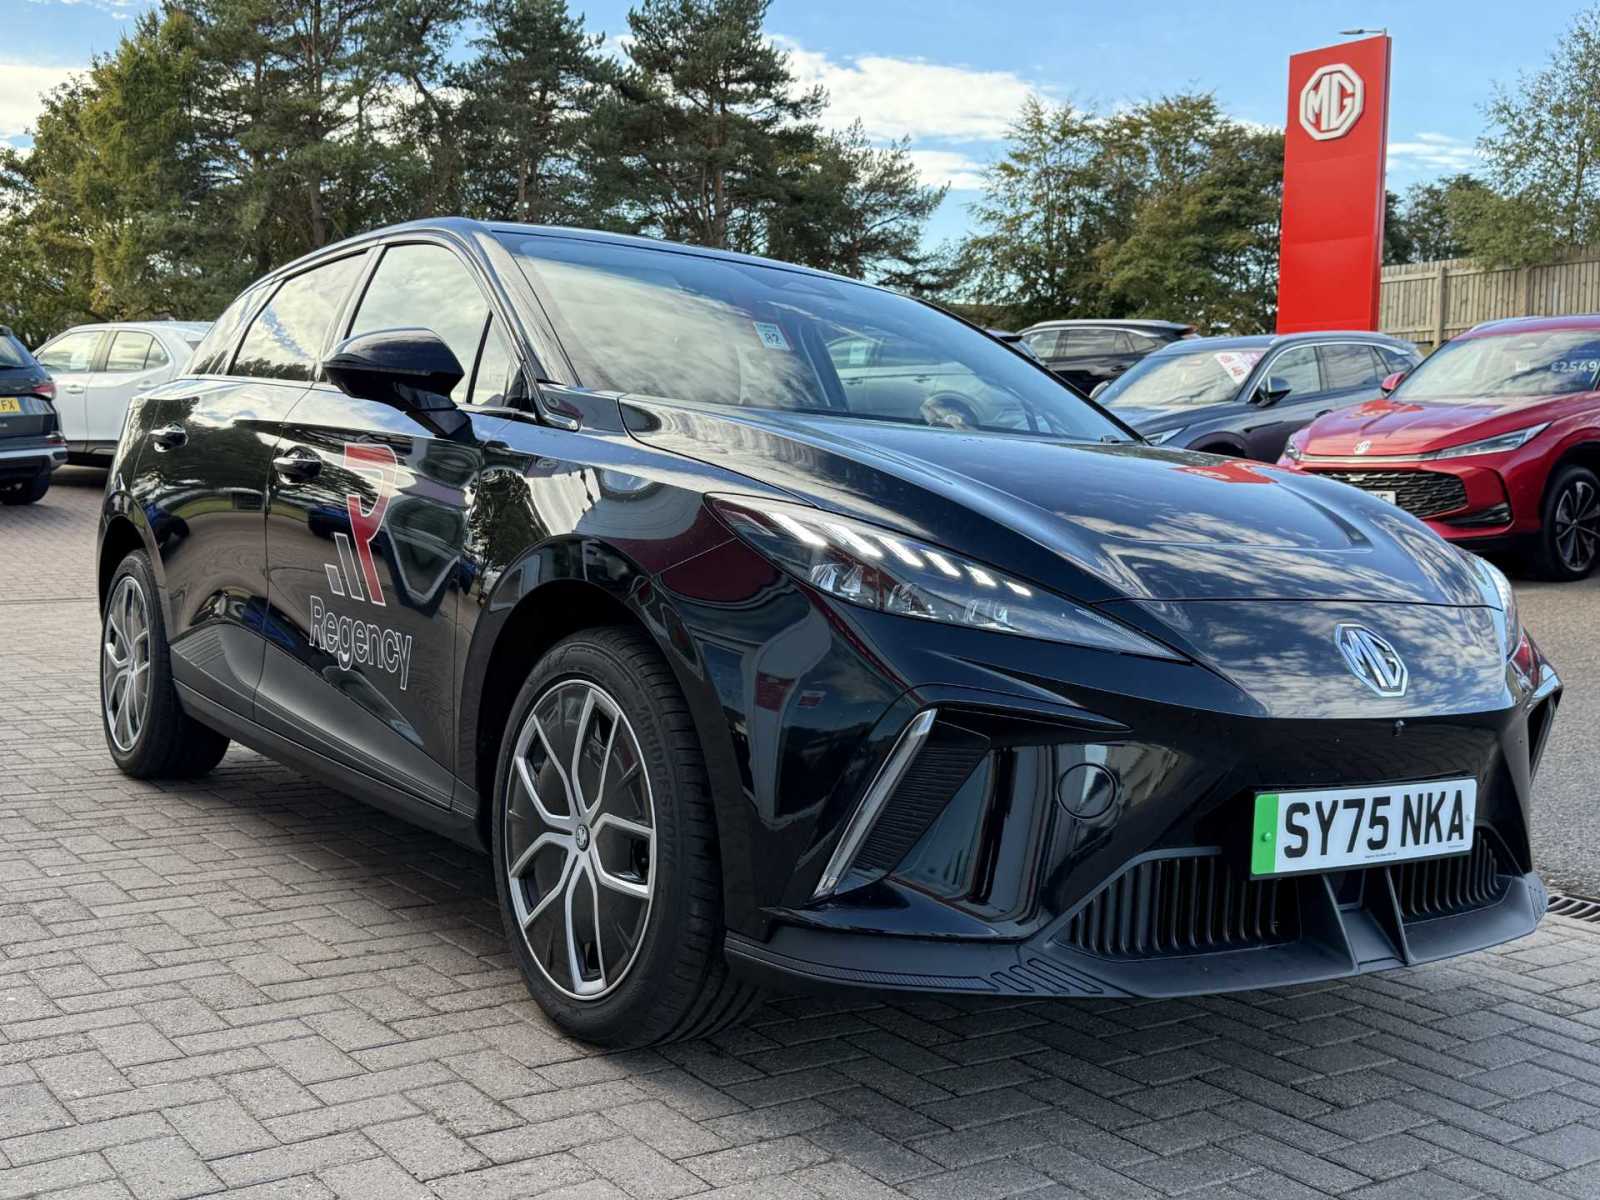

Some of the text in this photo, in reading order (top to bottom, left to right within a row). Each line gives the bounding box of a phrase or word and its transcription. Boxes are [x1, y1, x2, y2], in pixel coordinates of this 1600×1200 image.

[1304, 69, 1357, 133] MG
[308, 595, 412, 690] Regency
[1339, 626, 1403, 691] MG
[1283, 790, 1464, 859] SY75 NKA
